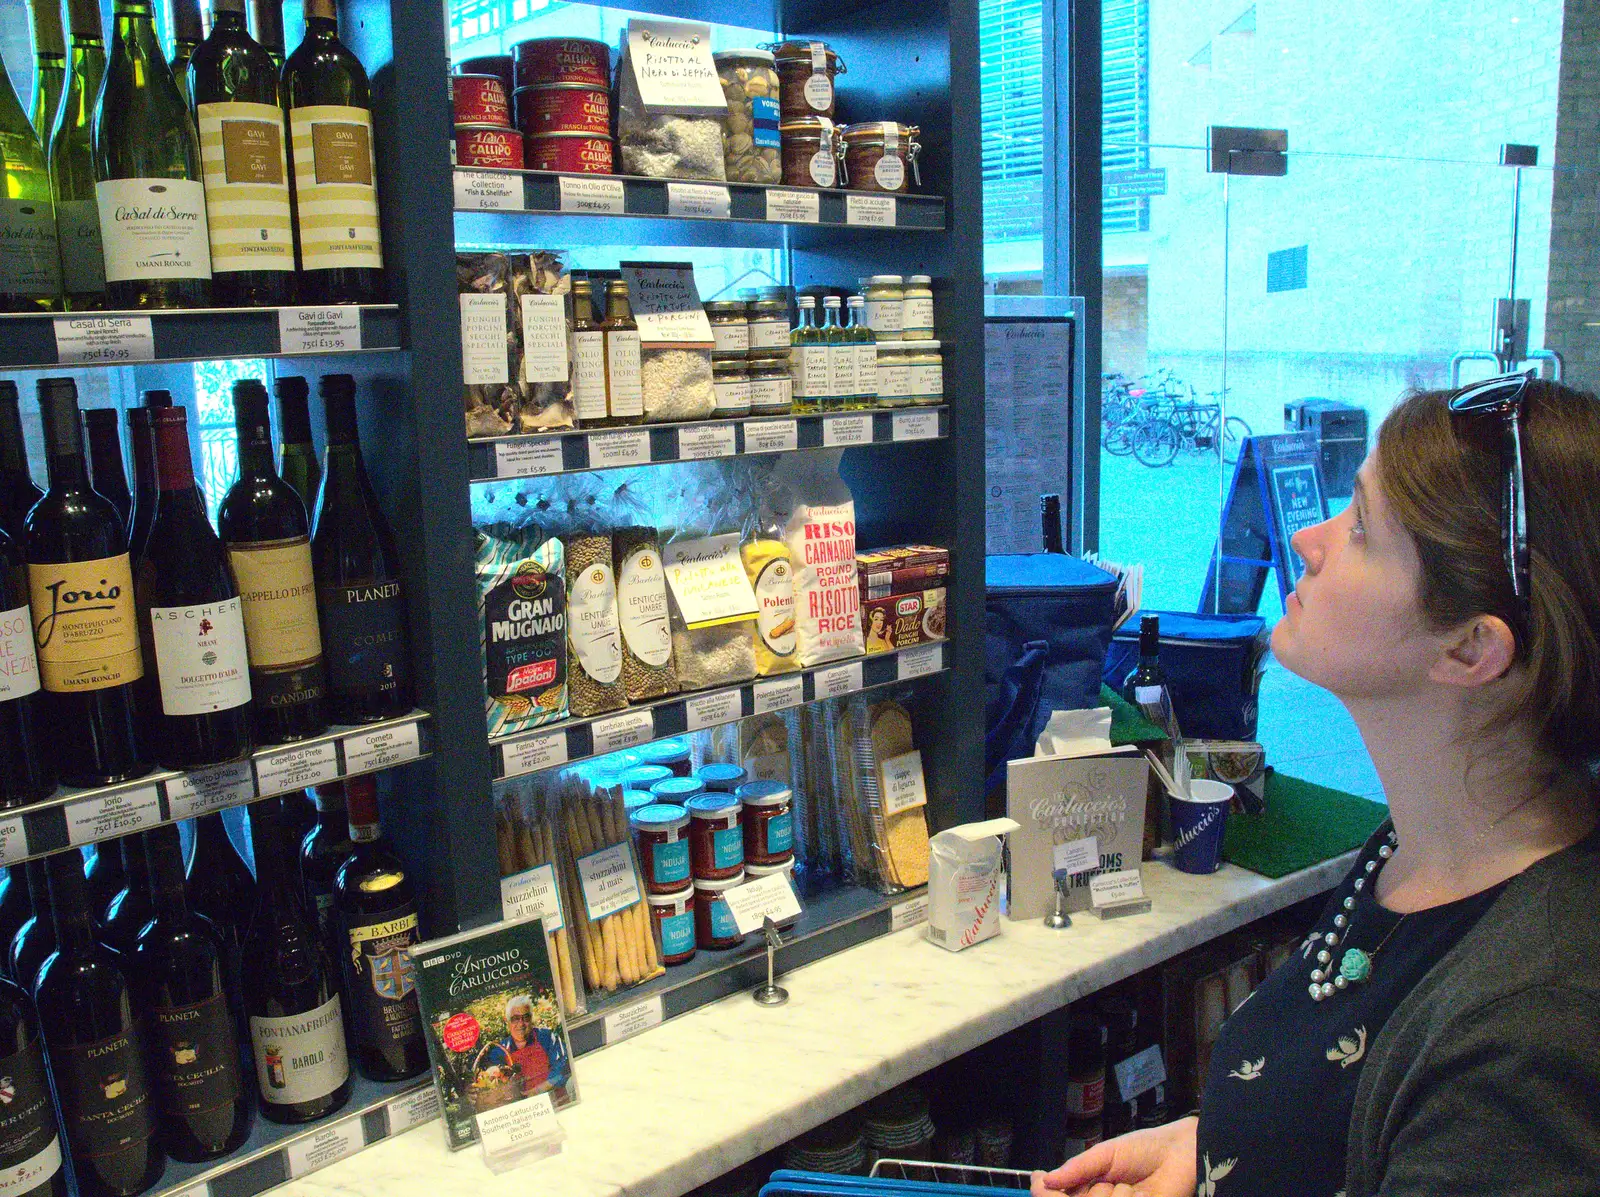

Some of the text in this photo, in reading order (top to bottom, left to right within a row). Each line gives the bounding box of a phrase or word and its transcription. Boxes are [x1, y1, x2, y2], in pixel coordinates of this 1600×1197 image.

[649, 37, 695, 50] Carluccio's
[247, 129, 265, 139] GAVI
[335, 131, 353, 140] GAVI
[469, 144, 512, 157] CALLIPO
[250, 163, 267, 172] GAVI
[339, 164, 355, 172] GAVI
[472, 181, 505, 189] Collection
[563, 181, 581, 189] Tonno
[481, 190, 486, 198] &
[480, 200, 499, 208] £5.00
[153, 206, 166, 221] di
[166, 206, 198, 221] Serra
[163, 260, 191, 268] RONCHI
[299, 310, 343, 321] Gavi di Gavi
[468, 316, 501, 324] FUNGHI
[70, 318, 132, 329] Casal di Serra
[467, 324, 505, 333] PORCINI
[528, 325, 566, 333] PORCINI
[470, 333, 501, 342] SECCHI
[530, 334, 561, 342] SECCHI
[302, 339, 345, 350] 75cl £13.95
[467, 342, 506, 350] SPECIALI
[82, 348, 130, 361] 75cl £9.95
[603, 450, 621, 458] 100ml
[531, 466, 547, 474] £5.95
[1287, 508, 1317, 522] EVENING
[804, 521, 855, 540] RISO
[681, 548, 724, 567] Carluccio's
[816, 564, 852, 578] ROUND
[819, 576, 852, 589] GRAIN
[240, 587, 299, 602] CAPPELLO DI
[347, 583, 400, 603] PLANETA
[639, 601, 662, 614] UMBRE
[809, 585, 858, 618] RISOTTO
[899, 601, 918, 613] STAR
[37, 579, 121, 649] Jorio
[154, 601, 241, 621] ASCHER
[508, 597, 553, 620] GRAN
[62, 616, 121, 631] MONTEPULCIANO
[492, 613, 563, 642] MUGNAIO
[818, 615, 855, 634] RICE
[895, 615, 920, 636] Dado
[63, 627, 104, 639] D'ABRUZZO
[898, 630, 918, 640] FUNGHI
[896, 636, 919, 647] PORCINI
[506, 653, 527, 665] TYPE
[63, 671, 121, 686] UMANI RONCHI
[181, 673, 218, 684] DOLCETTO
[510, 668, 554, 690] Spadoni
[380, 681, 397, 692] 2013
[756, 690, 776, 700] Polenta
[600, 721, 624, 733] Umbrian
[366, 733, 394, 746] Cometa
[516, 741, 535, 752] Farina
[270, 747, 323, 767] Capello di Prete
[364, 758, 378, 769] 75cl
[532, 754, 551, 766] £2.00
[182, 769, 238, 788] Dolcetto D'Alba
[279, 770, 322, 788] 75cl £12.00
[104, 796, 123, 808] Jorio
[190, 801, 207, 812] 75cl
[94, 816, 142, 836] 75cl £10.50
[589, 860, 627, 882] stuzzichini
[598, 876, 623, 892] al mais
[506, 885, 548, 905] stuzzichini
[515, 900, 545, 917] al mais
[371, 918, 411, 938] BARBI
[423, 950, 462, 968] BBC DVD
[450, 947, 520, 978] ANTONIO
[449, 958, 530, 997] CARLUCCIO'S
[159, 1009, 201, 1023] PLANETA
[259, 1008, 341, 1037] FONTANAFREDDA
[87, 1037, 129, 1059] PLANETA
[292, 1050, 325, 1070] BAROLO
[187, 1063, 225, 1081] CECILIA
[484, 1112, 509, 1127] Antonio
[512, 1113, 532, 1126] Italian
[532, 1108, 550, 1119] Feast
[315, 1129, 336, 1142] Barolo
[510, 1129, 534, 1142] £10.00
